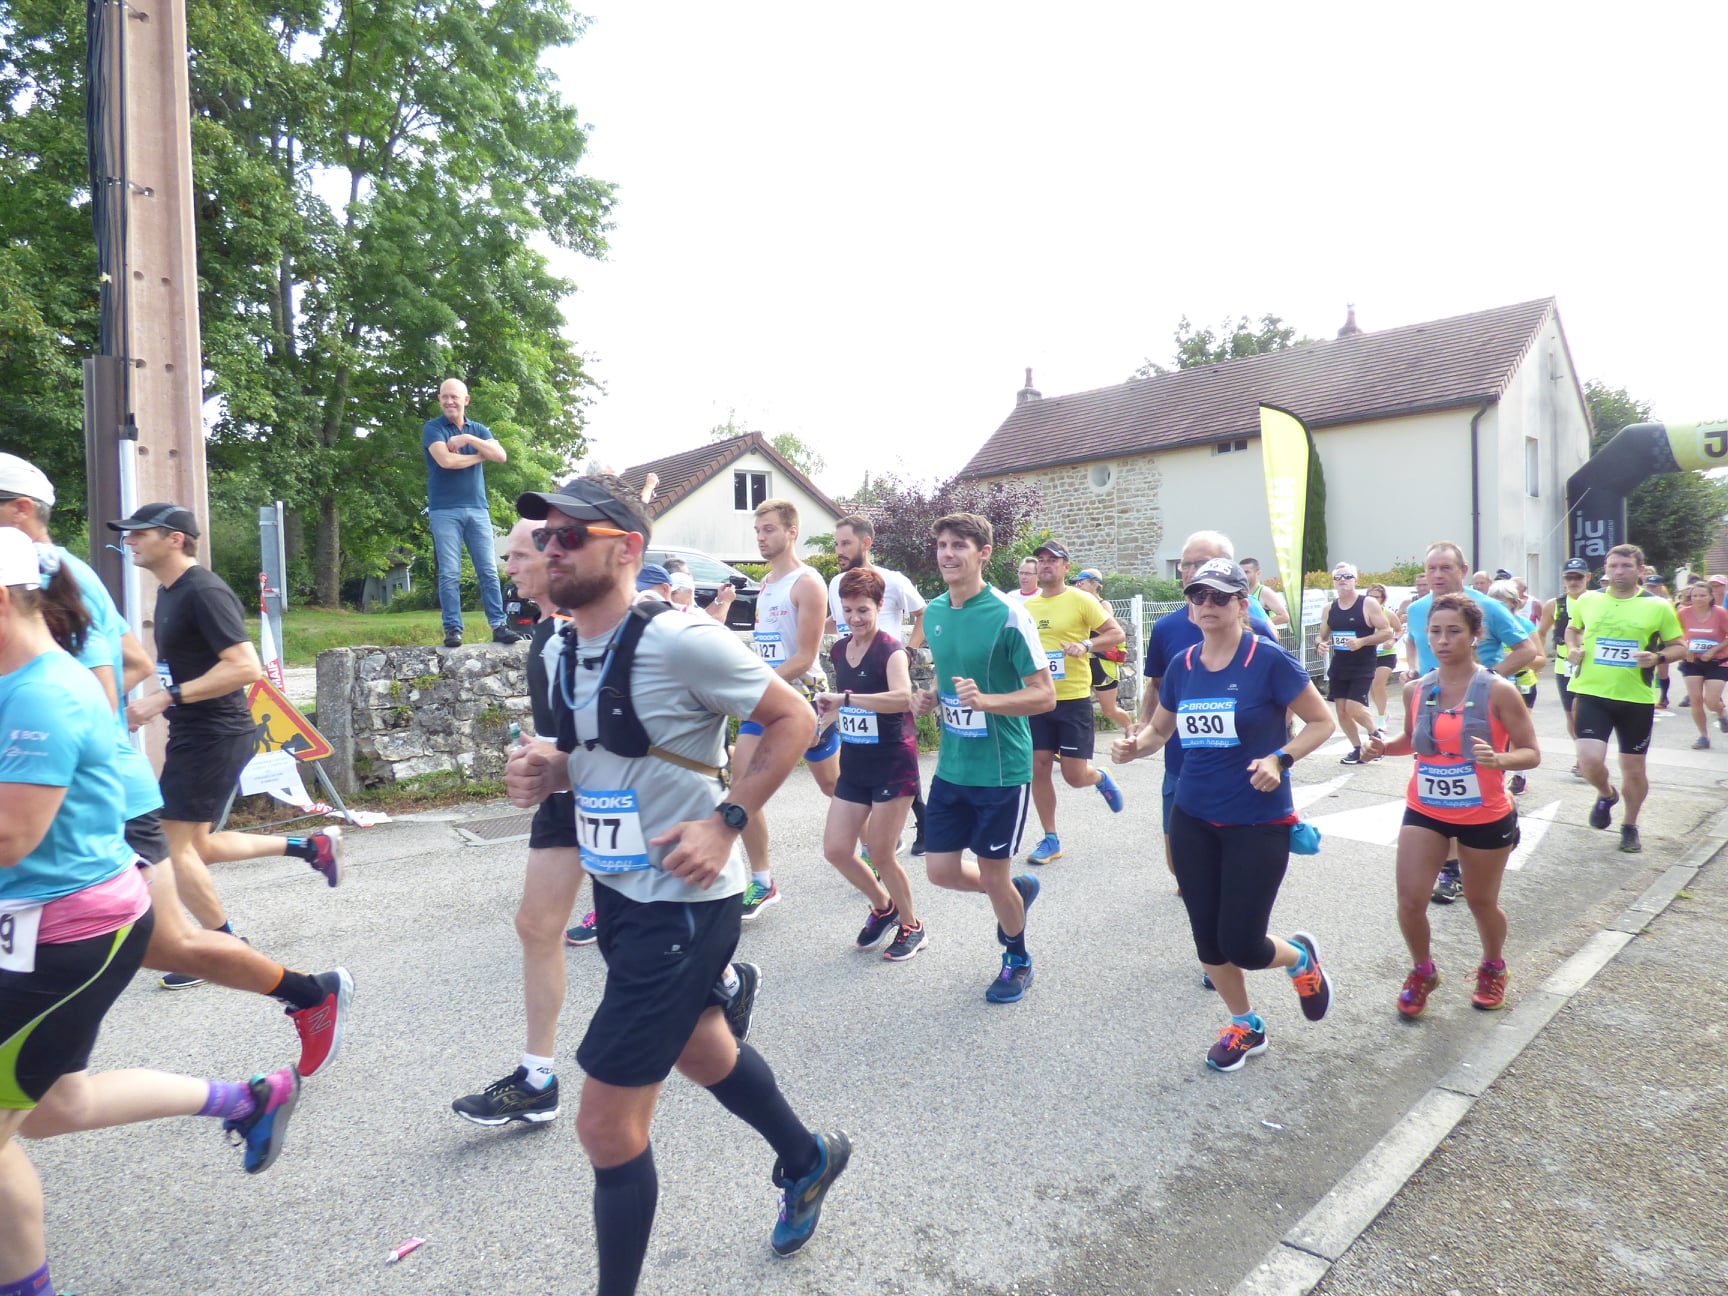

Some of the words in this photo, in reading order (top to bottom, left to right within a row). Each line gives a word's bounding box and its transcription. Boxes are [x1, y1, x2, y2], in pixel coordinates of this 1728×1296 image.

[1601, 646, 1630, 660] 775
[1049, 660, 1058, 672] 6
[1188, 701, 1234, 711] BROOKS
[842, 716, 869, 733] 814
[945, 706, 974, 726] 817
[1186, 714, 1225, 735] 830
[1428, 765, 1473, 776] BROOKS
[1424, 777, 1467, 797] 795
[579, 813, 622, 850] 777
